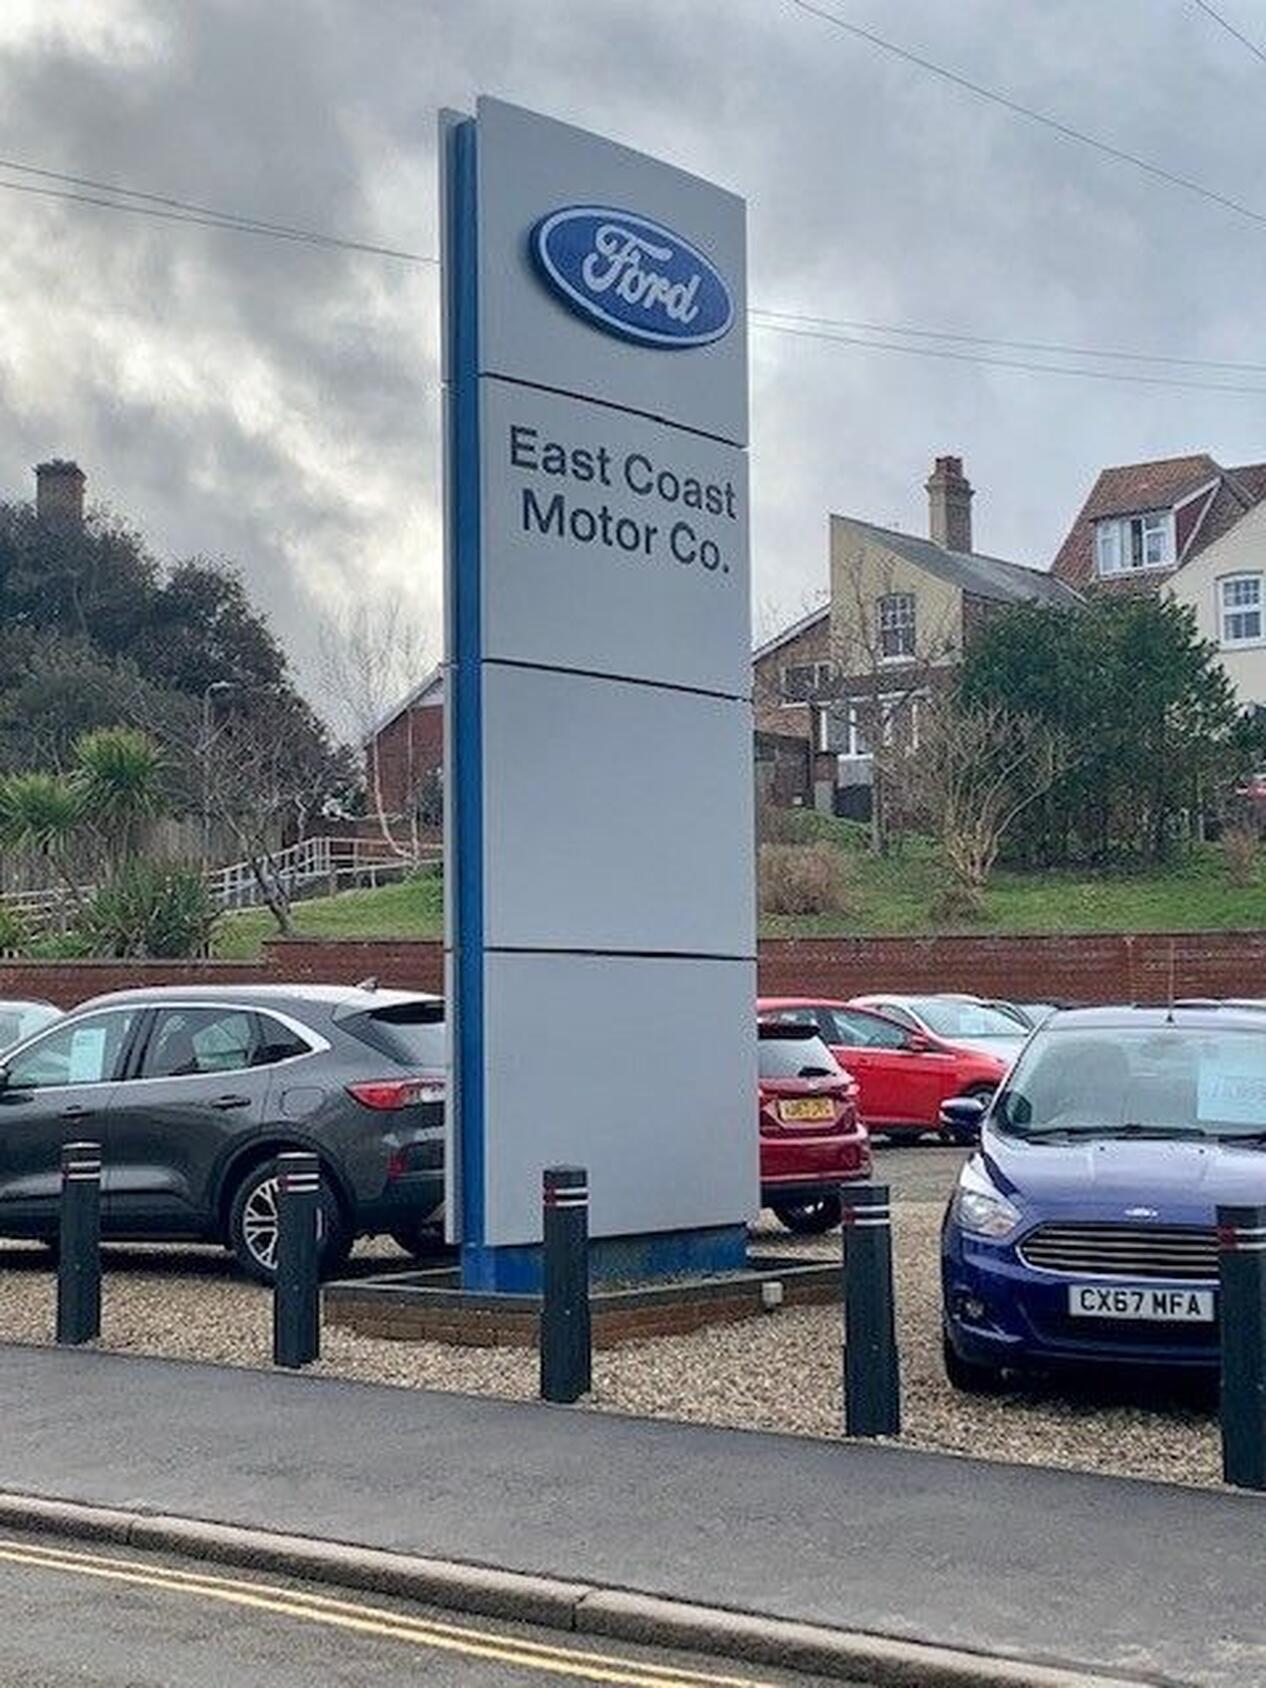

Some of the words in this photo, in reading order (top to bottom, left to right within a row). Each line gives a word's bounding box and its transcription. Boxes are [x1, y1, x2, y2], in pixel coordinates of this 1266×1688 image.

[583, 224, 700, 323] Ford
[510, 424, 612, 486] East
[623, 453, 737, 519] Coast
[522, 488, 658, 554] Motor
[669, 521, 730, 573] Co.
[1080, 1289, 1144, 1313] CX67
